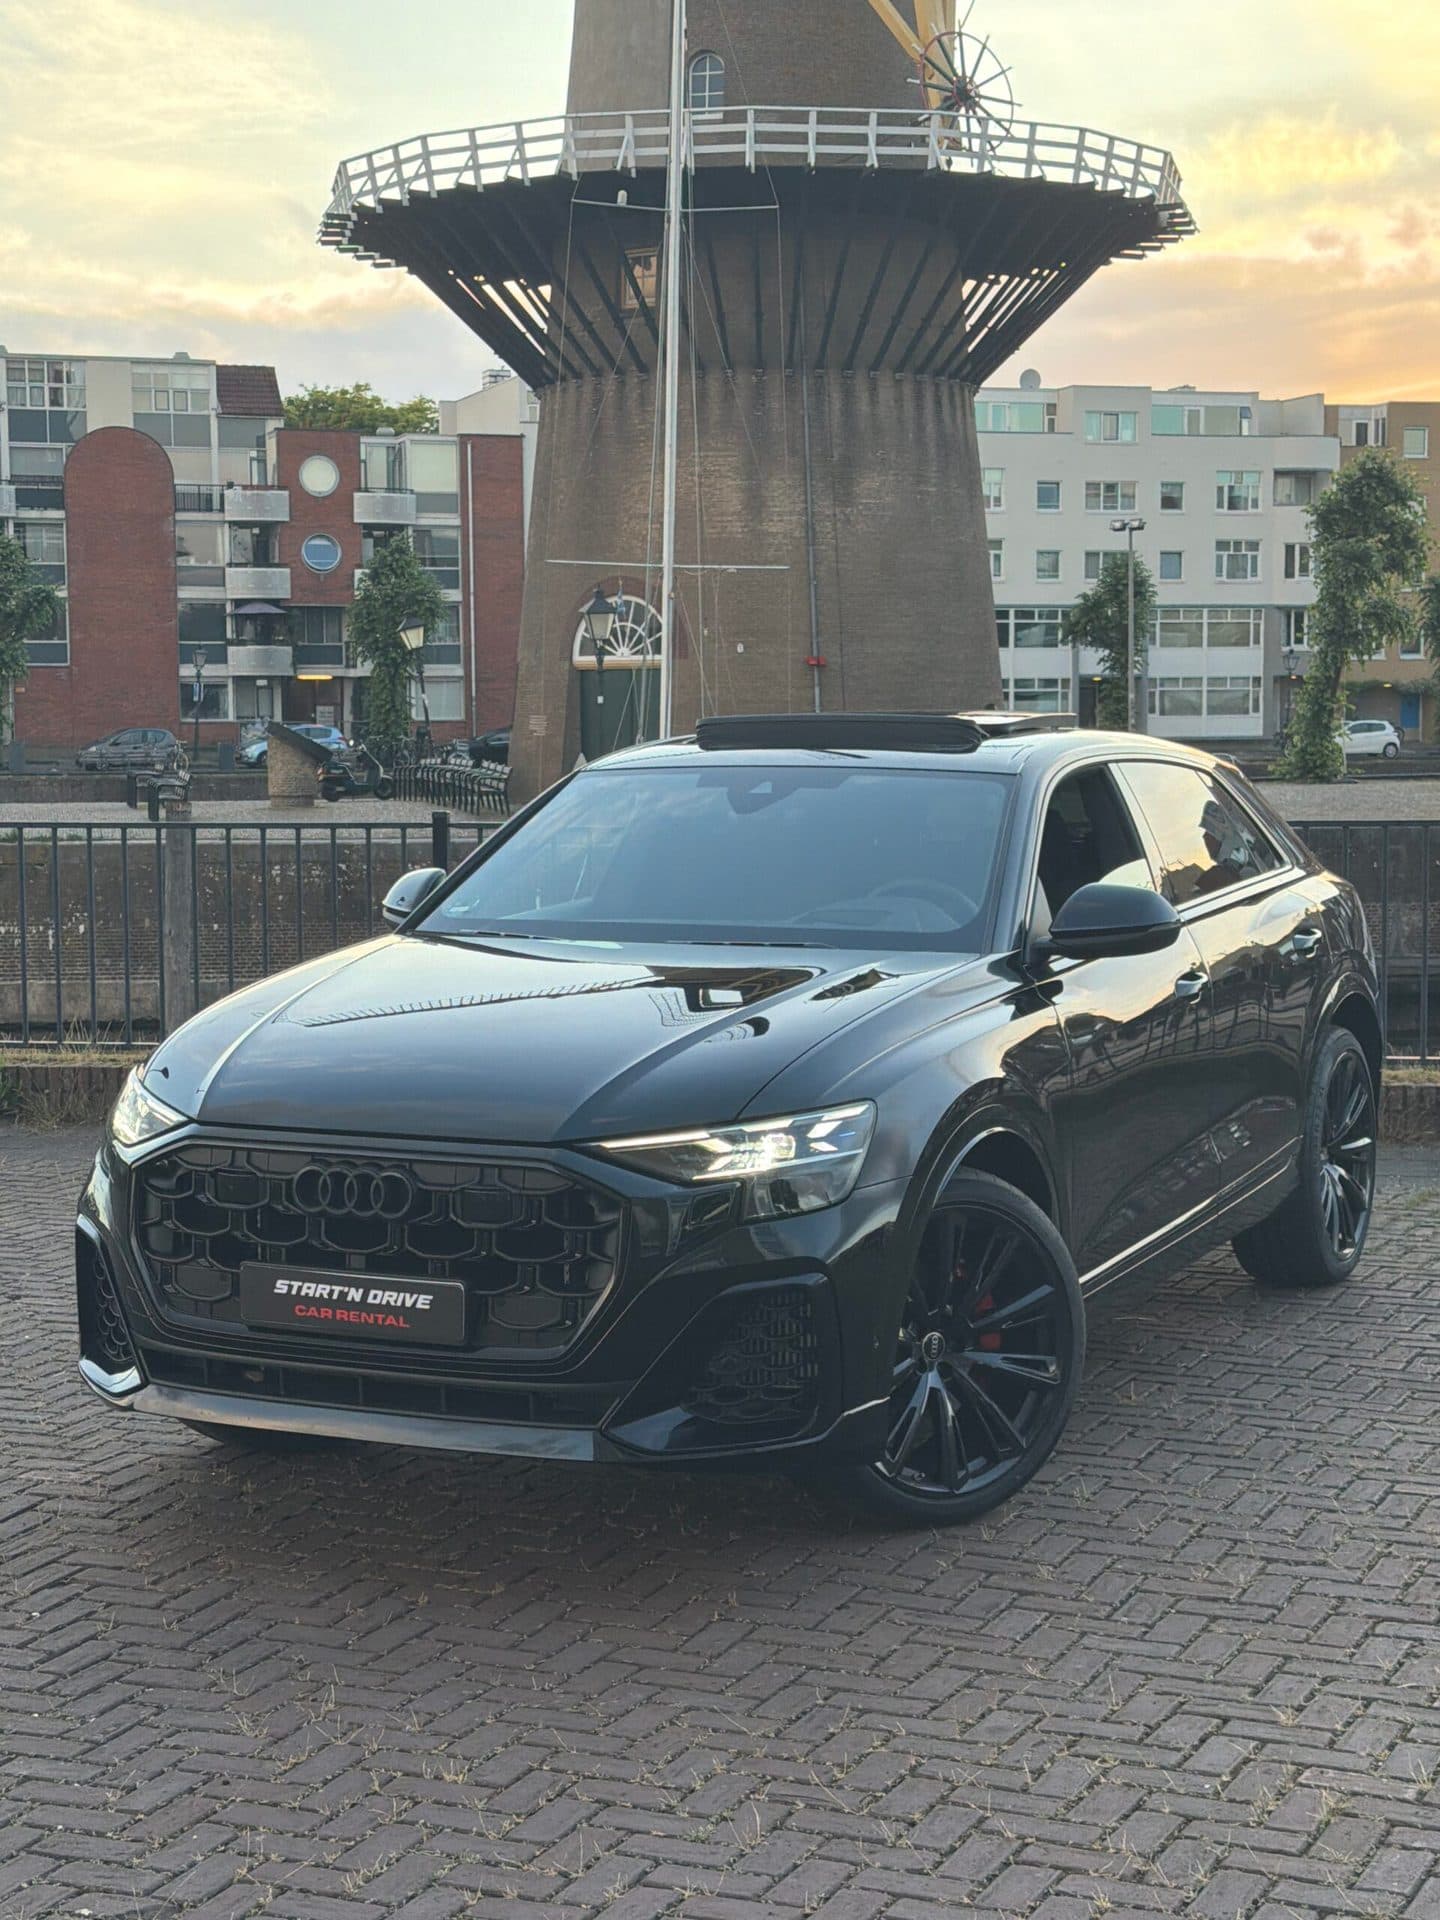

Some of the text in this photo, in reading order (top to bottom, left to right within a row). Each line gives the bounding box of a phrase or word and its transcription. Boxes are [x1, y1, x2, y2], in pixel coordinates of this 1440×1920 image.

[273, 1279, 433, 1309] START'N DRIVE
[295, 1304, 410, 1328] CAR RENTAL
